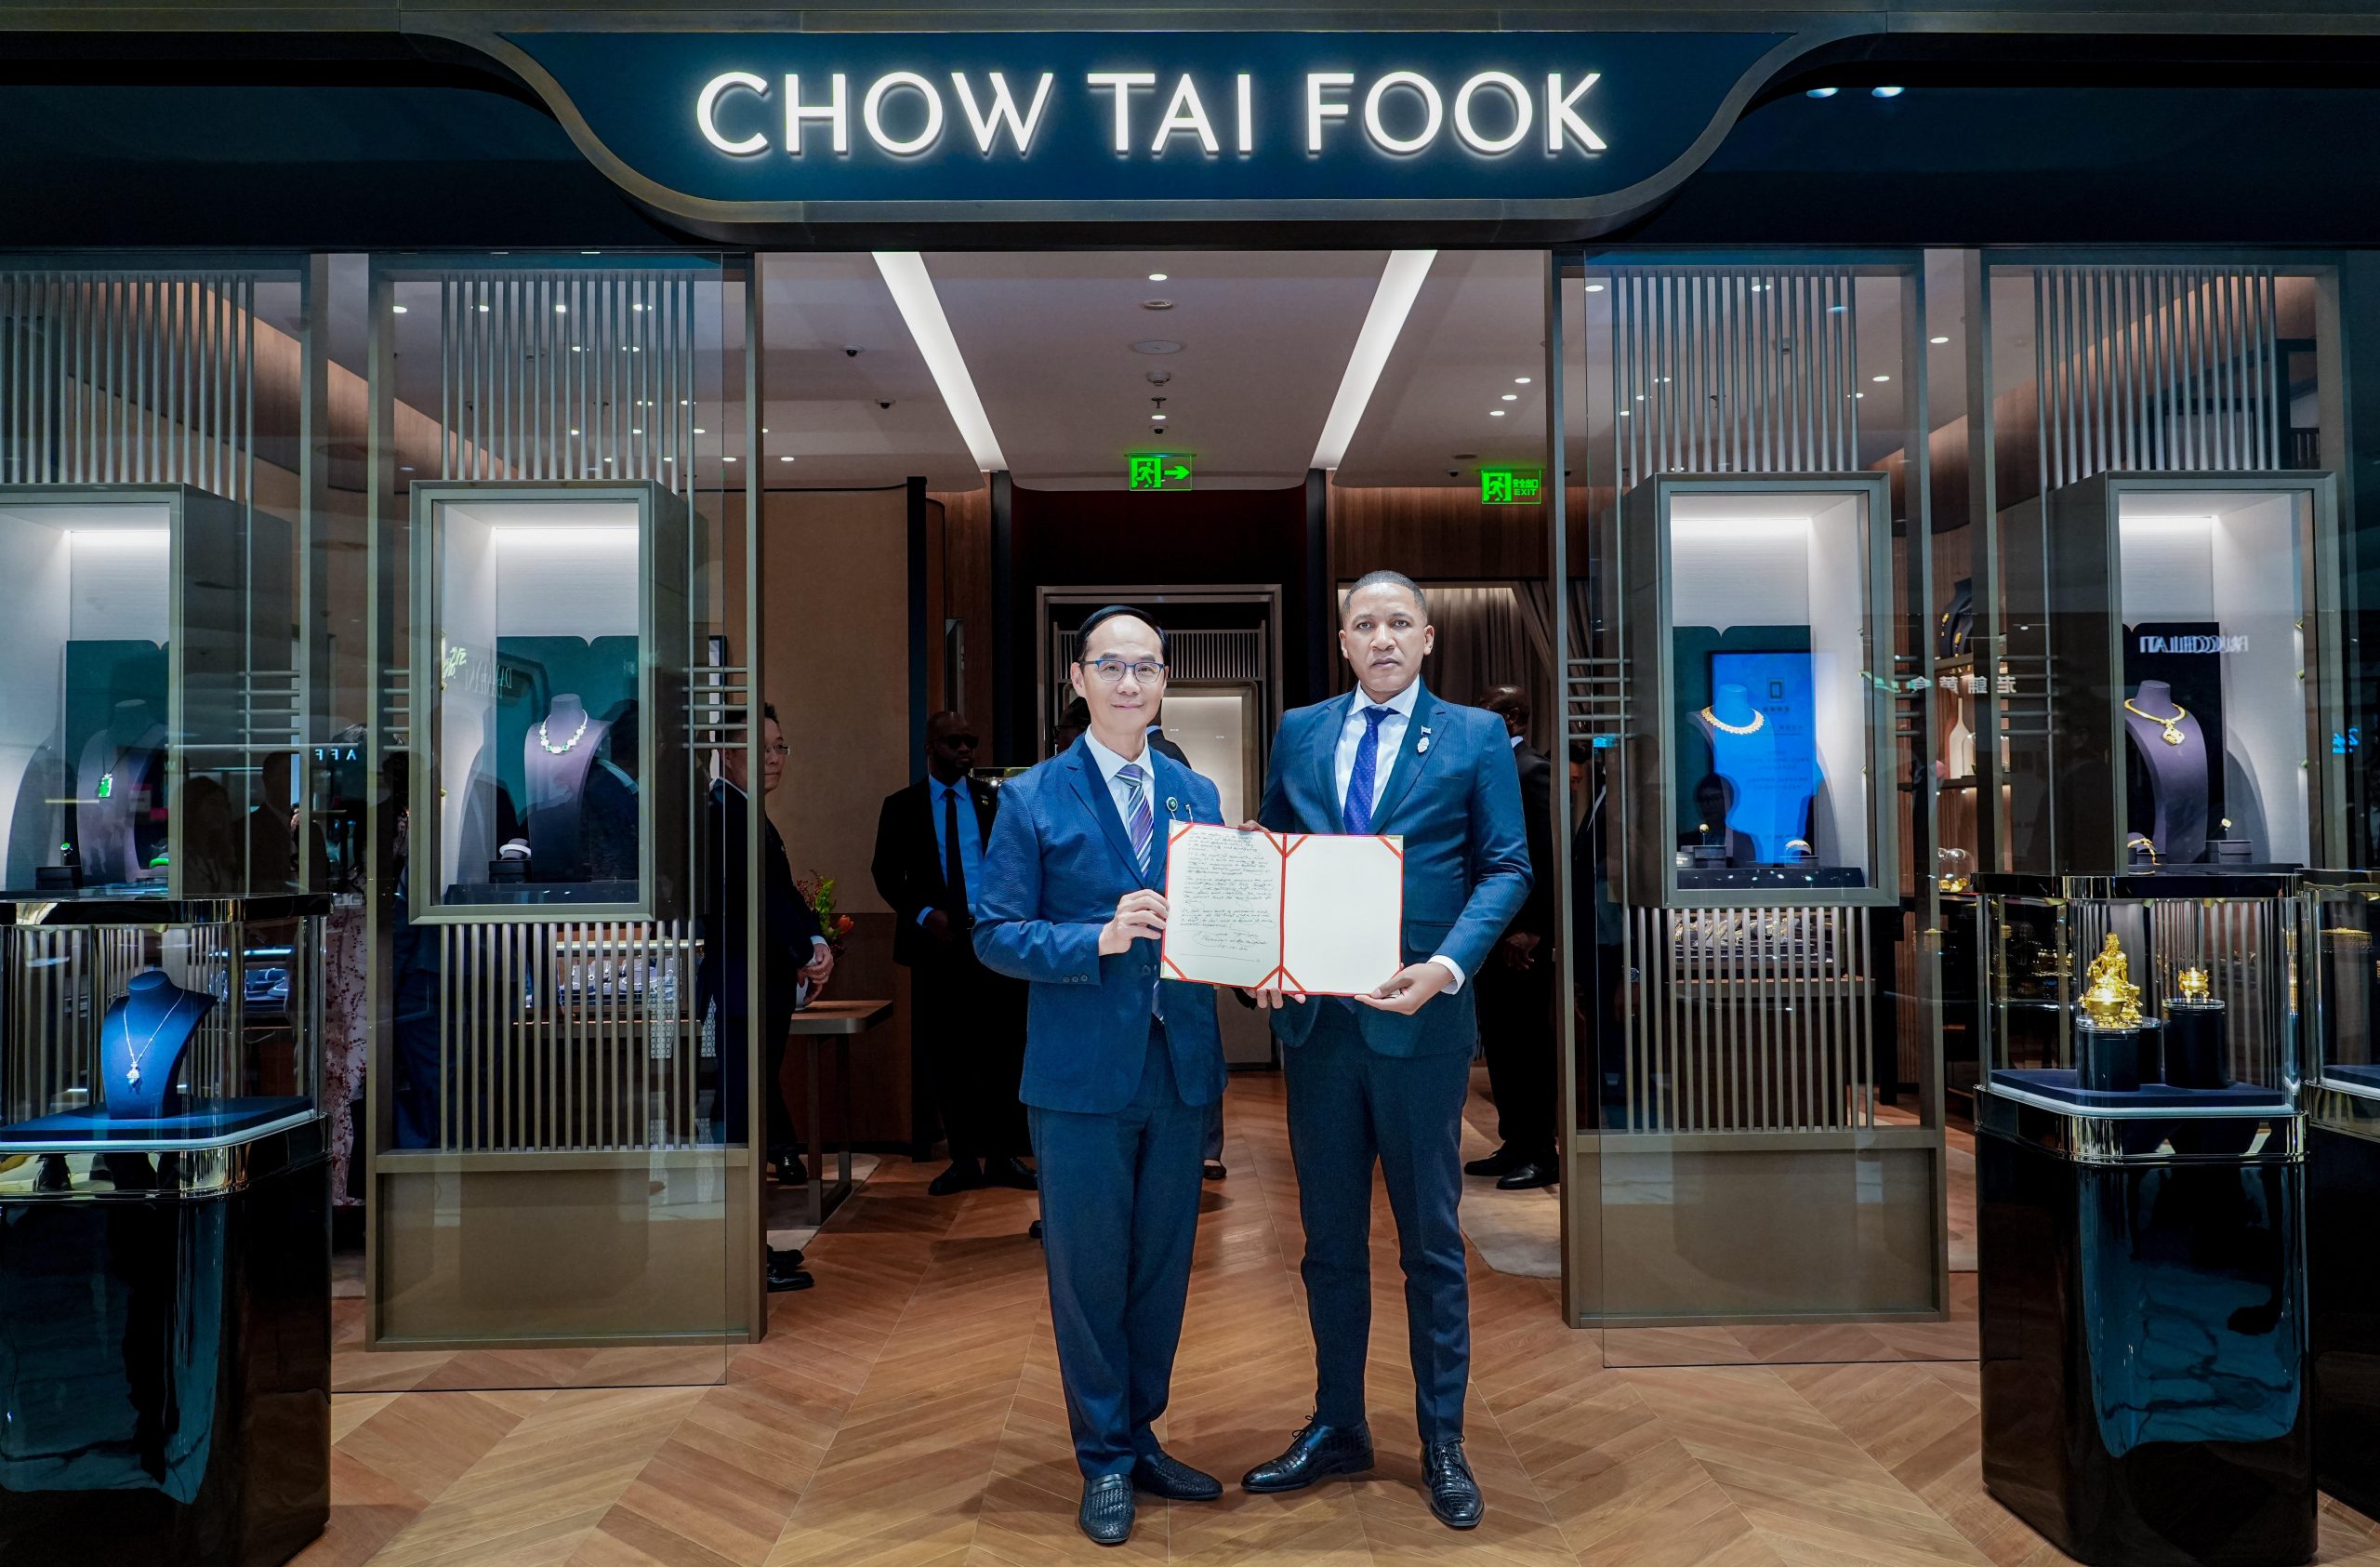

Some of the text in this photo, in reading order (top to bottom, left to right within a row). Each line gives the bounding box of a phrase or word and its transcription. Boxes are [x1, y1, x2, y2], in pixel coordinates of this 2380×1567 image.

[695, 71, 1608, 155] CHOW TAI FOOK
